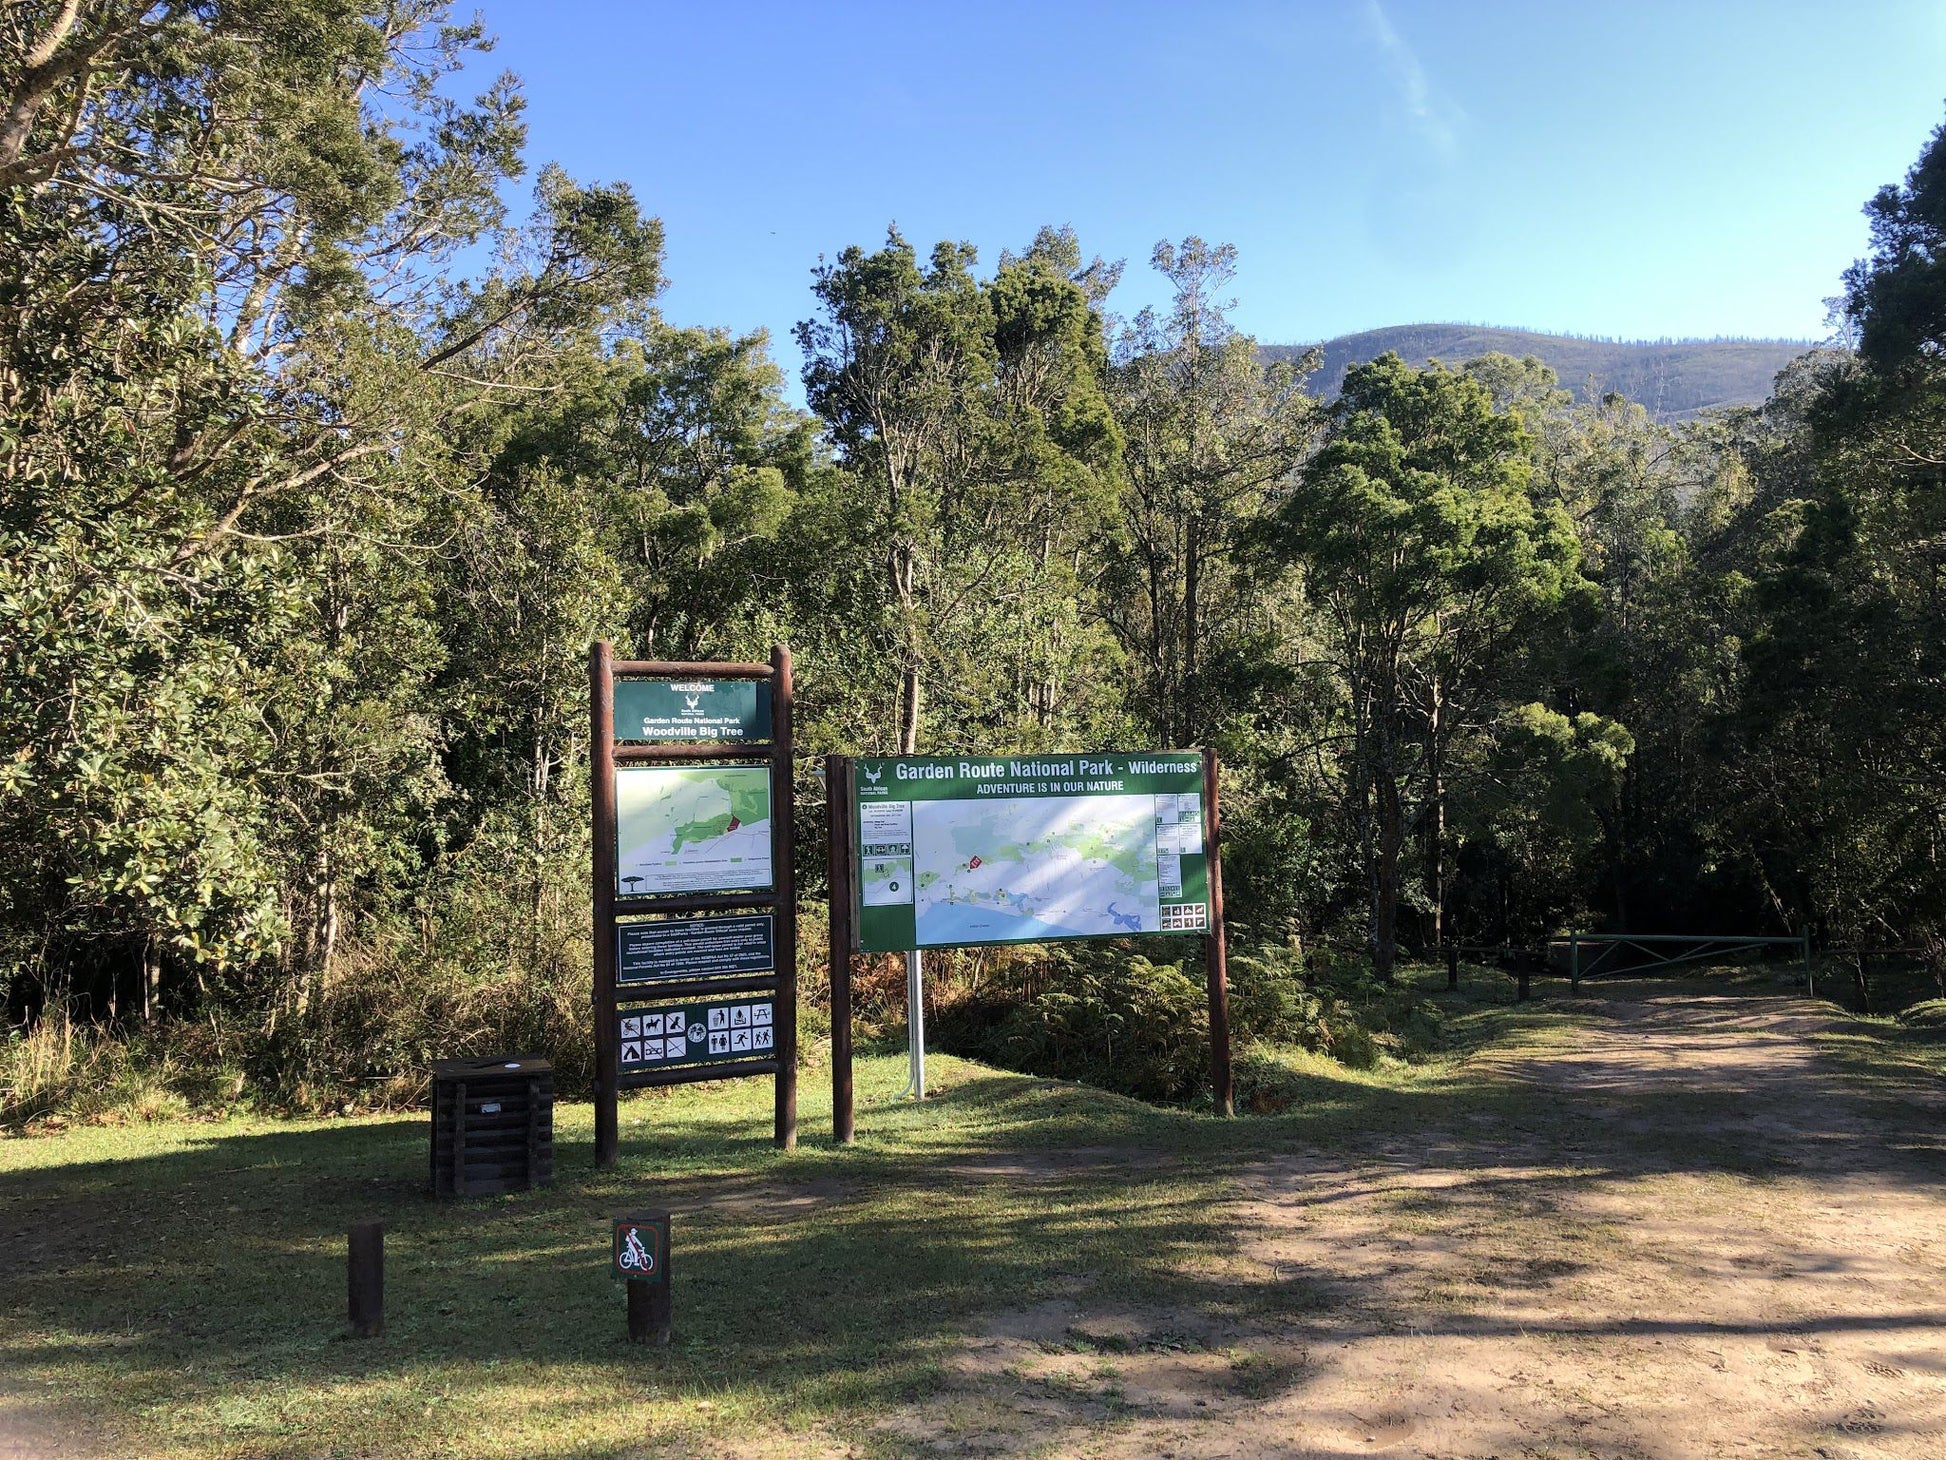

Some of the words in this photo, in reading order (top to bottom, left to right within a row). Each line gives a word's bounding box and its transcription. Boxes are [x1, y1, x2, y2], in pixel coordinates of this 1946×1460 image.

[670, 684, 715, 692] WELCOME
[642, 727, 697, 736] Woodville
[700, 727, 718, 738] Big
[721, 727, 744, 736] Tree
[896, 763, 954, 780] Garden
[959, 762, 1005, 778] Route
[1010, 760, 1074, 777] National
[1079, 759, 1114, 775] Park
[1128, 761, 1197, 775] Wilderness
[977, 783, 1035, 795] ADVENTURE
[1038, 782, 1048, 793] IS
[1050, 782, 1061, 792] IN
[1064, 781, 1084, 792] OUR
[1086, 780, 1124, 791] NATURE
